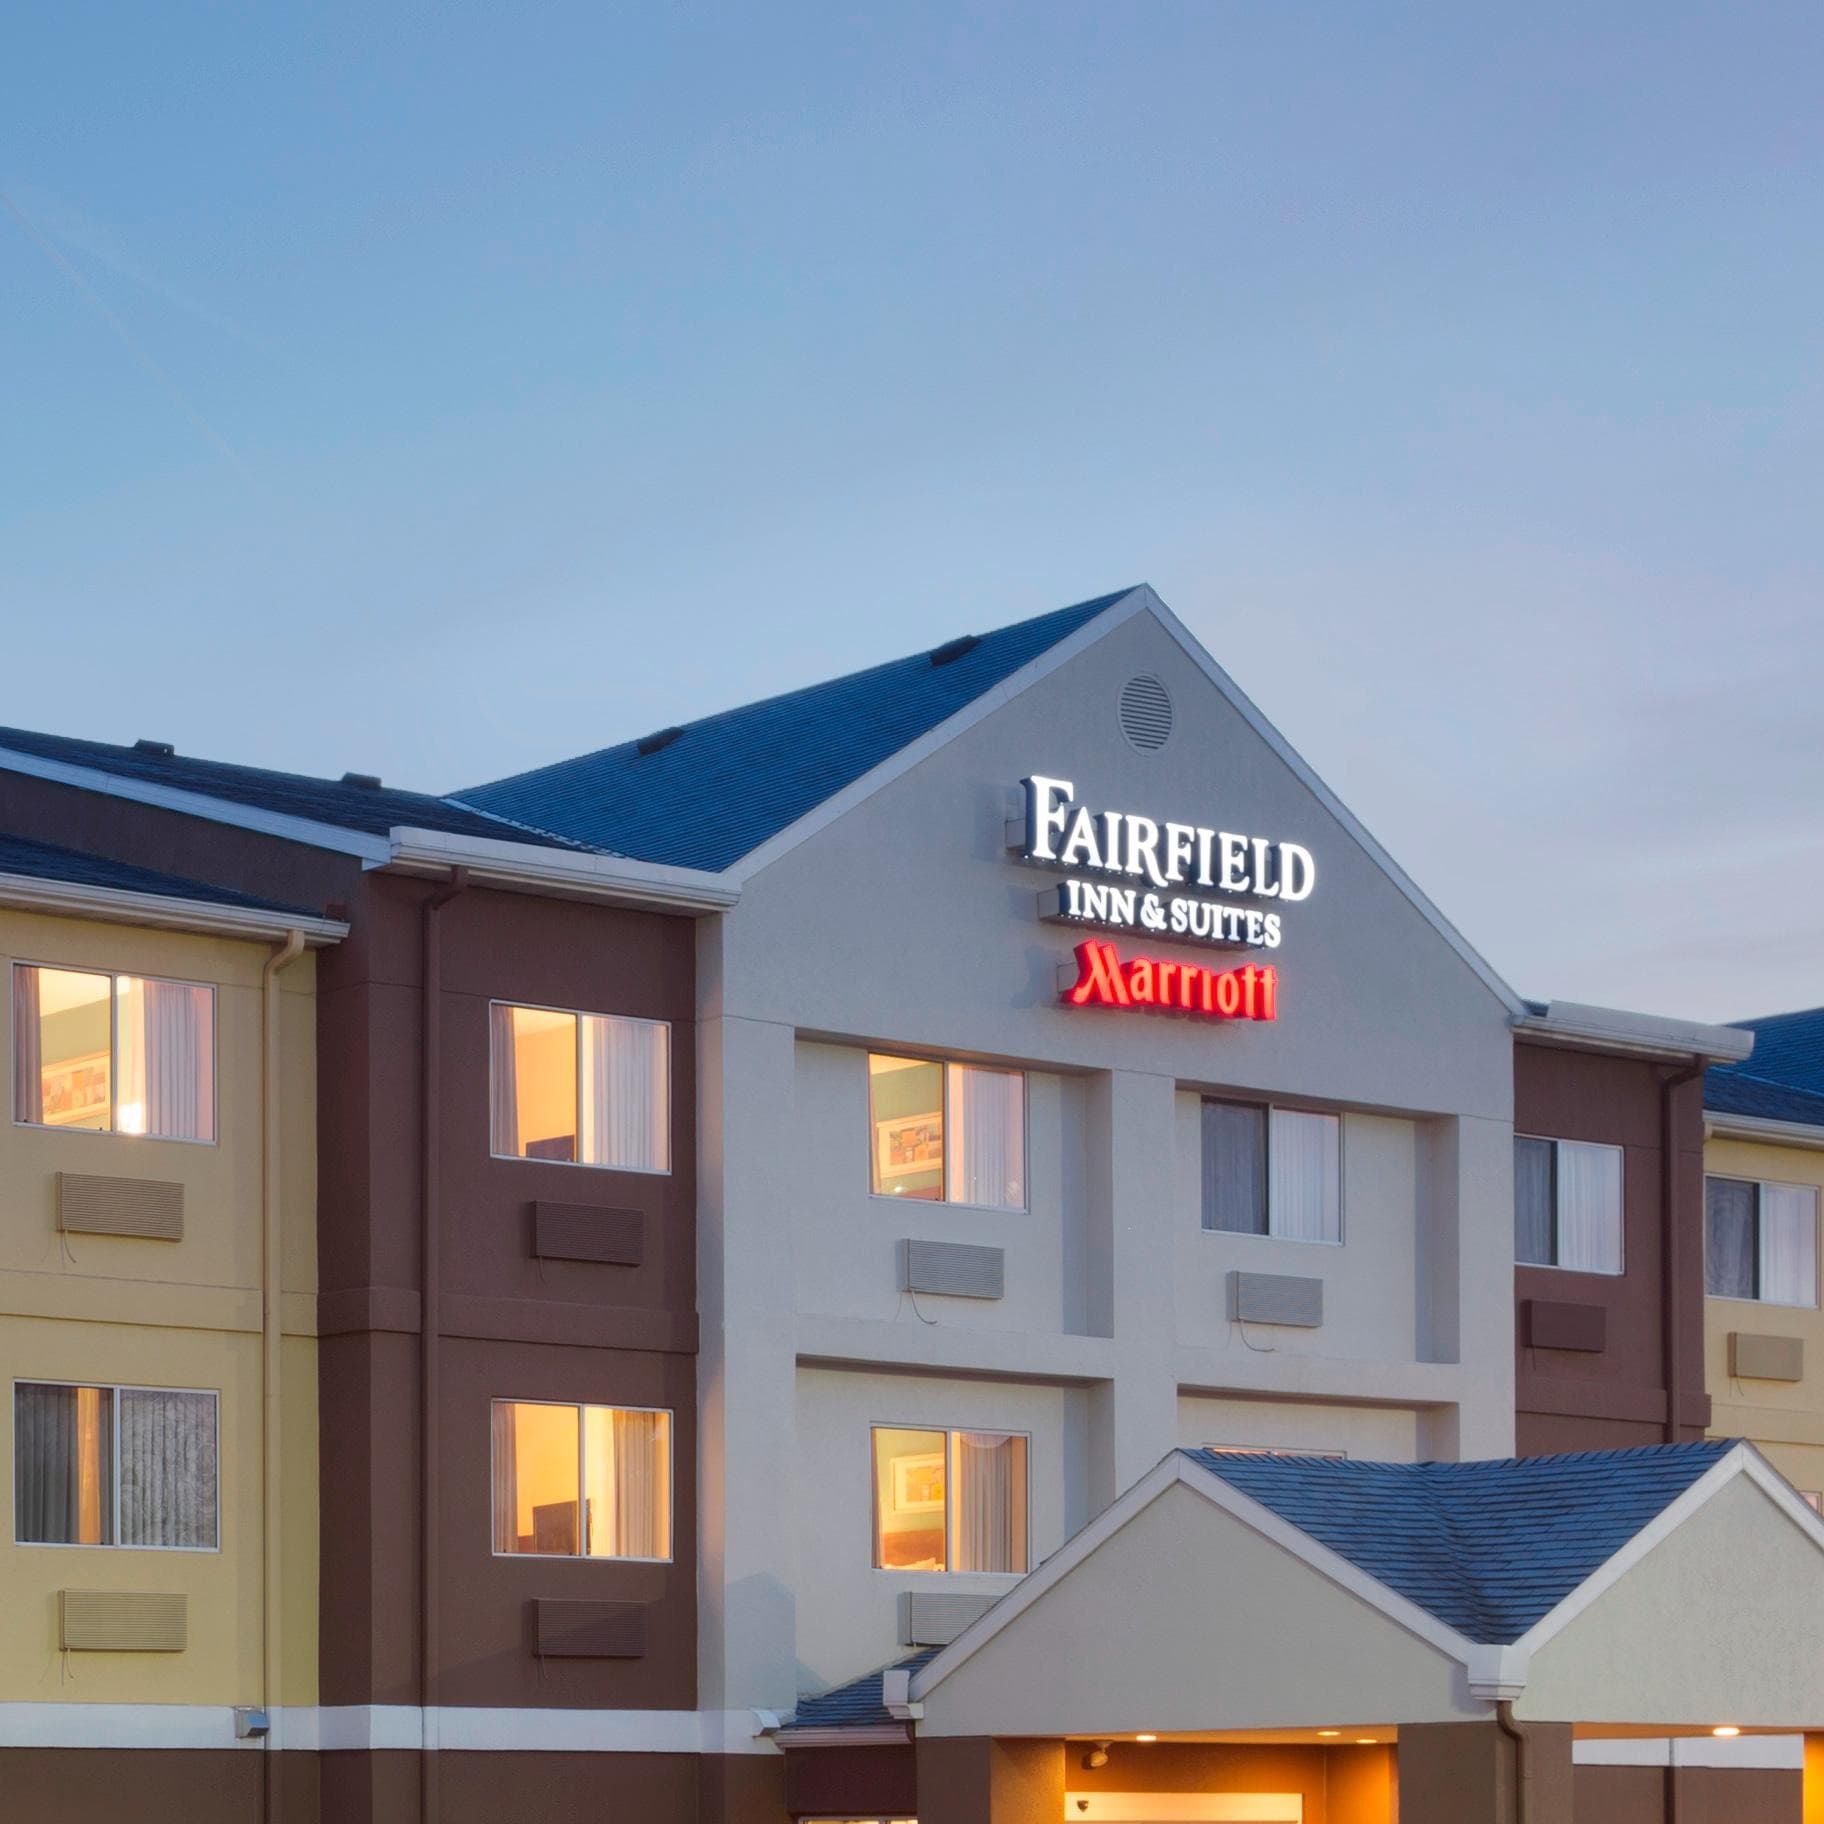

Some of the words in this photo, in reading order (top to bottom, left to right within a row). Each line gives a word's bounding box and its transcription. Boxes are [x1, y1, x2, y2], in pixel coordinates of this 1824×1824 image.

[1029, 774, 1316, 902] FAIRFIELD
[1065, 879, 1137, 926] INN
[1140, 892, 1167, 931] &
[1170, 897, 1282, 949] SUITES
[1071, 938, 1277, 1022] Marriott
